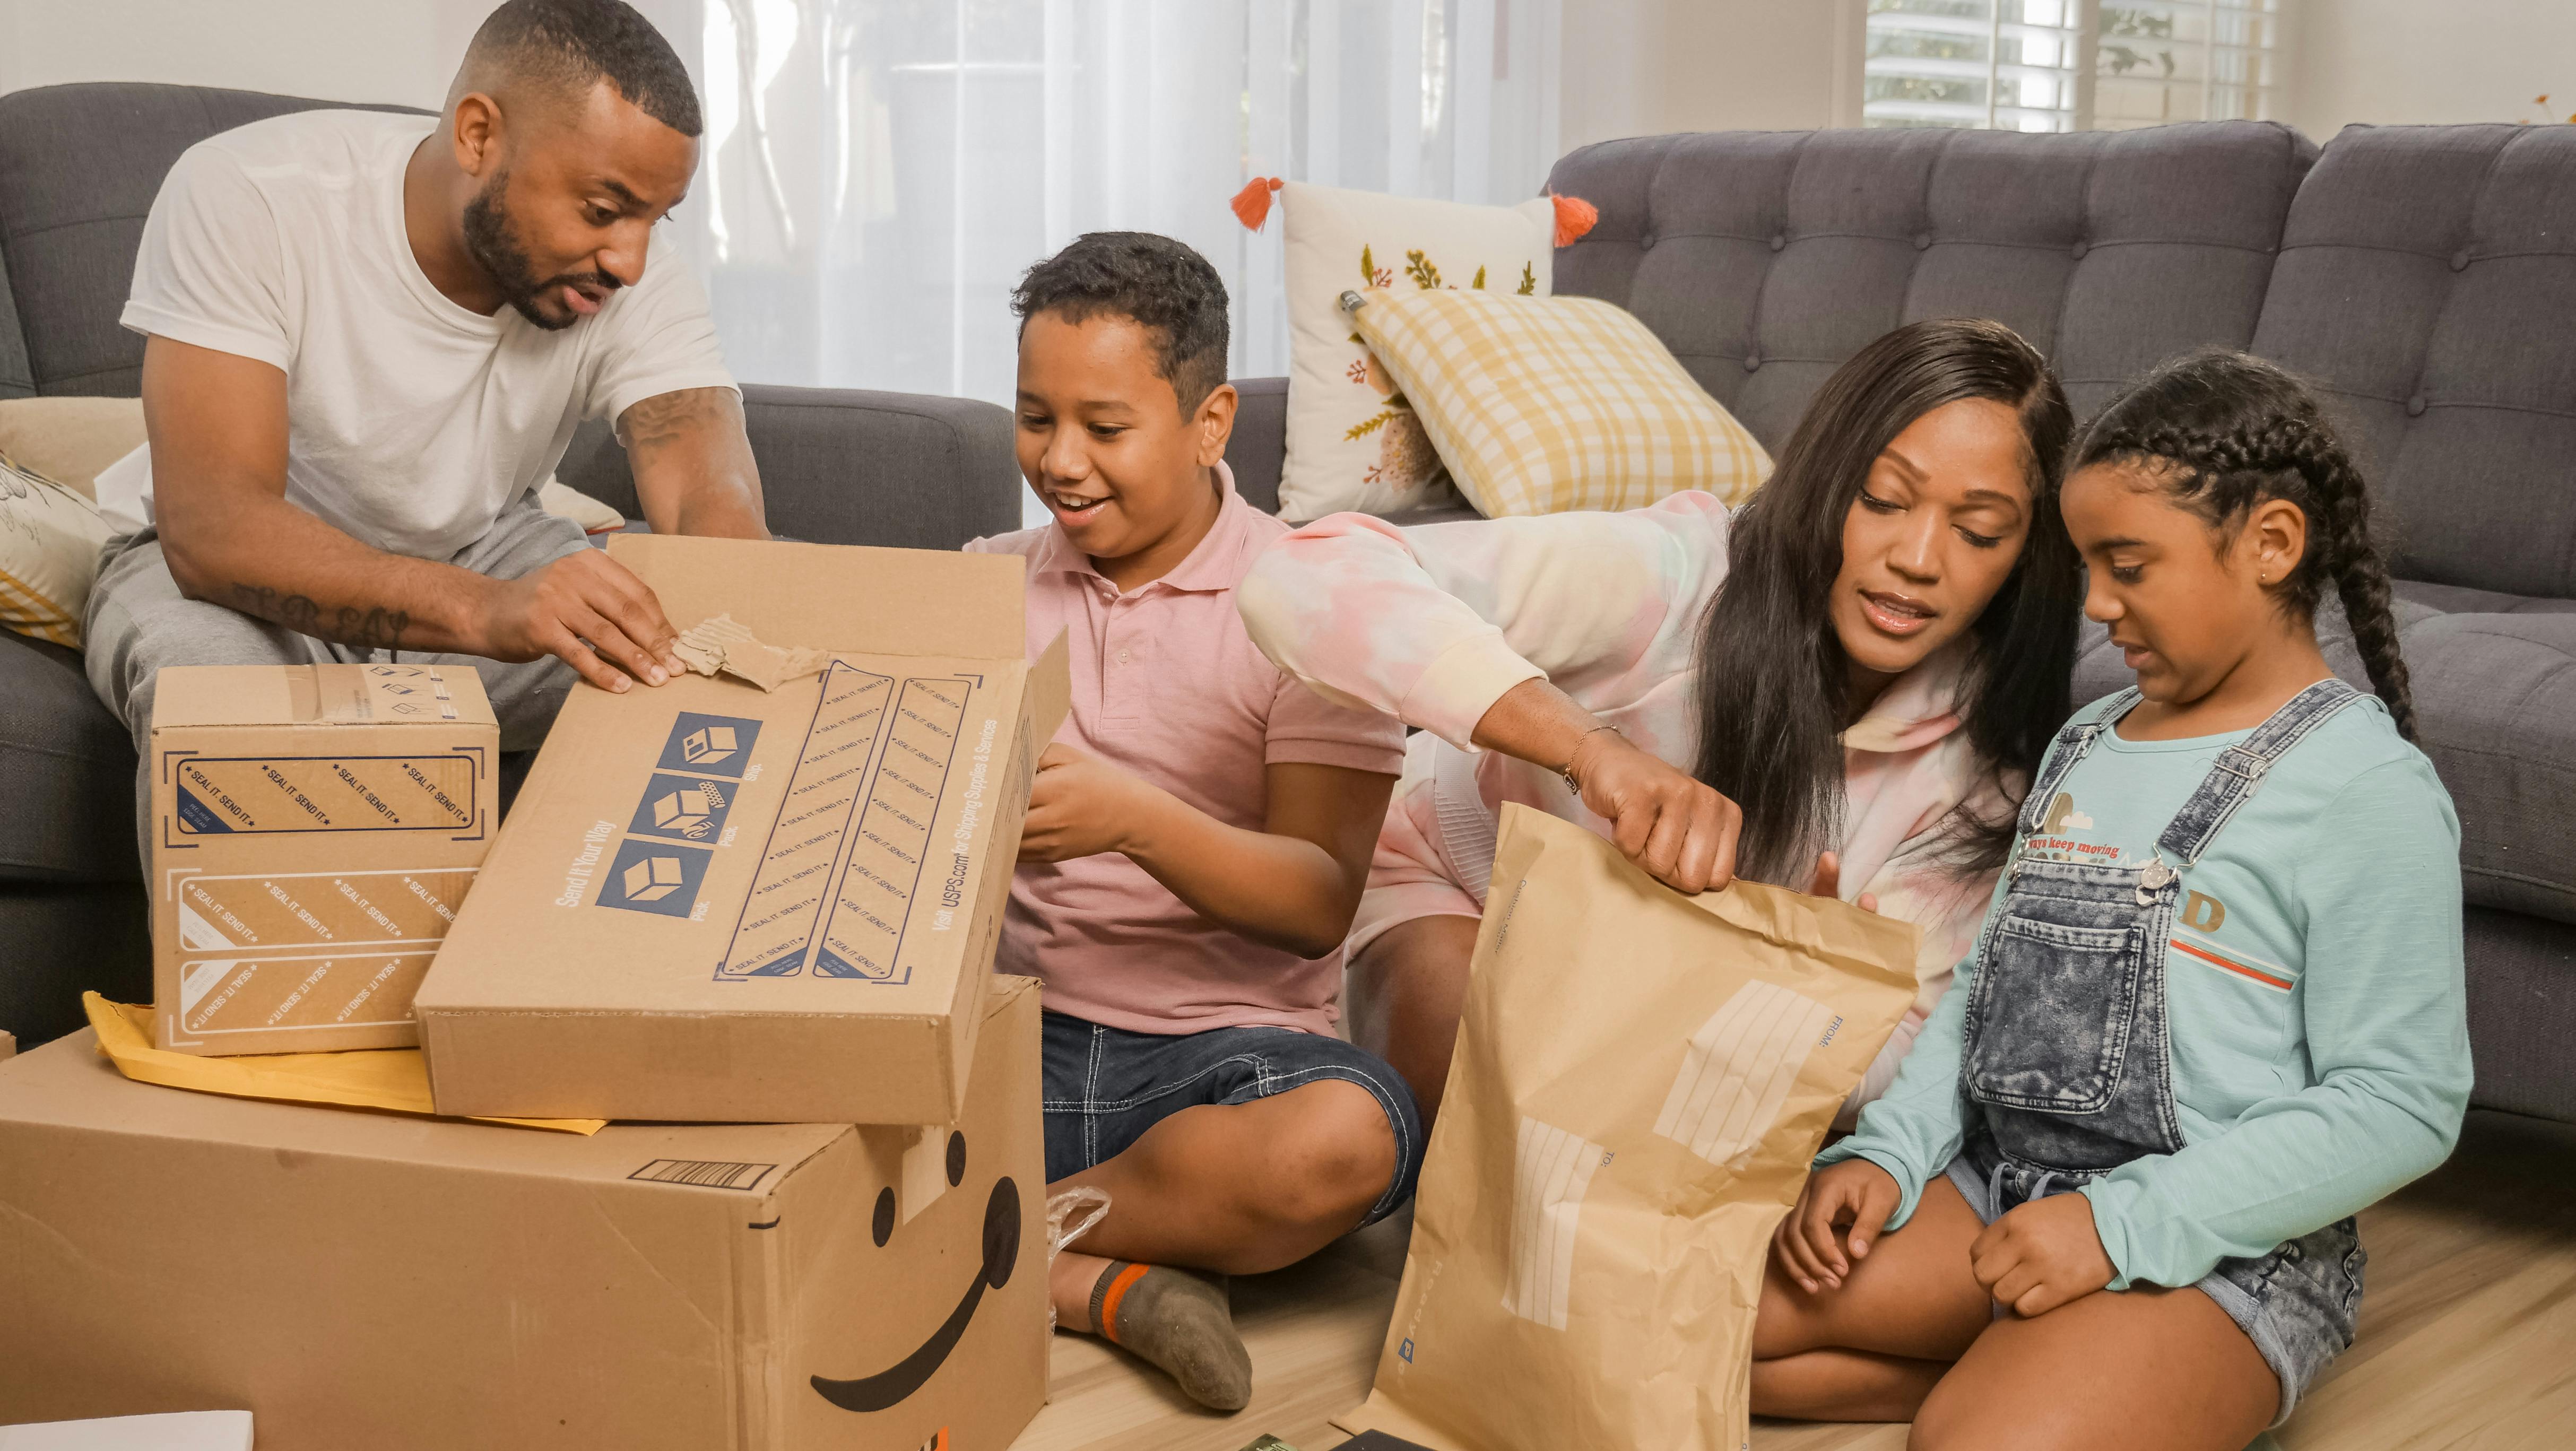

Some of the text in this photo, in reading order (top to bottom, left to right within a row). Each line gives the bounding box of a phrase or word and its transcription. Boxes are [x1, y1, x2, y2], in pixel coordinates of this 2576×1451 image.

[832, 694, 849, 702] SEAL
[857, 683, 877, 692] SEND
[848, 713, 867, 722] SEND
[975, 719, 998, 754] Services
[811, 753, 829, 762] SEAL
[837, 742, 857, 751] SEND
[896, 741, 910, 749] SEAL
[916, 752, 933, 762] SEND
[744, 763, 762, 781] Ship.
[799, 784, 818, 793] SEAL
[827, 772, 847, 781] SEND
[886, 771, 901, 779] SEAL
[907, 783, 924, 793] SEND
[964, 763, 988, 799] Supplies
[191, 771, 250, 823] SEAL IT. SEND IT.
[268, 770, 326, 822] SEAL IT. SEND IT.
[339, 769, 395, 820] SEAL IT. SEND IT.
[408, 768, 464, 819] SEAL IT. SEND IT.
[787, 815, 807, 824] SEAL
[816, 803, 836, 813] SEND
[877, 801, 891, 811] SEAL
[898, 814, 915, 825] SEND
[954, 800, 983, 840] Shipping
[719, 826, 739, 847] Pack.
[775, 848, 795, 857] SEAL
[804, 836, 825, 846] SEND
[866, 833, 882, 843] SEAL
[888, 847, 906, 858] SEND
[951, 840, 969, 854] for
[2049, 837, 2075, 852] keep
[2076, 843, 2120, 858] moving
[556, 820, 617, 907] Send It Your Way
[763, 882, 784, 892] SEAL
[793, 868, 814, 879] SEND
[856, 866, 871, 876] SEAL
[877, 881, 896, 892] SEND
[410, 882, 428, 900] SEAL
[426, 897, 438, 907] IT.
[194, 888, 253, 939] SEAL IT. SEND IT.
[270, 885, 328, 936] SEAL IT. SEND IT.
[341, 883, 397, 933] SEAL IT. SEND IT.
[691, 901, 710, 922] Pick.
[750, 918, 771, 929] SEAL
[780, 904, 802, 915] SEND
[845, 901, 861, 912] SEAL
[866, 916, 886, 928] SEND
[932, 909, 954, 931] Visit
[735, 959, 757, 970] SEAL
[767, 943, 789, 955] SEND
[832, 941, 849, 951] SEAL
[855, 955, 874, 968] SEND
[196, 970, 251, 1024] SEAL IT. SEND IT.
[271, 967, 326, 1020] SEAL IT. SEND IT.
[341, 963, 395, 1017] SEAL IT. SEND IT.
[1819, 1015, 1843, 1047] FROM:
[1601, 1152, 1615, 1167] TO:
